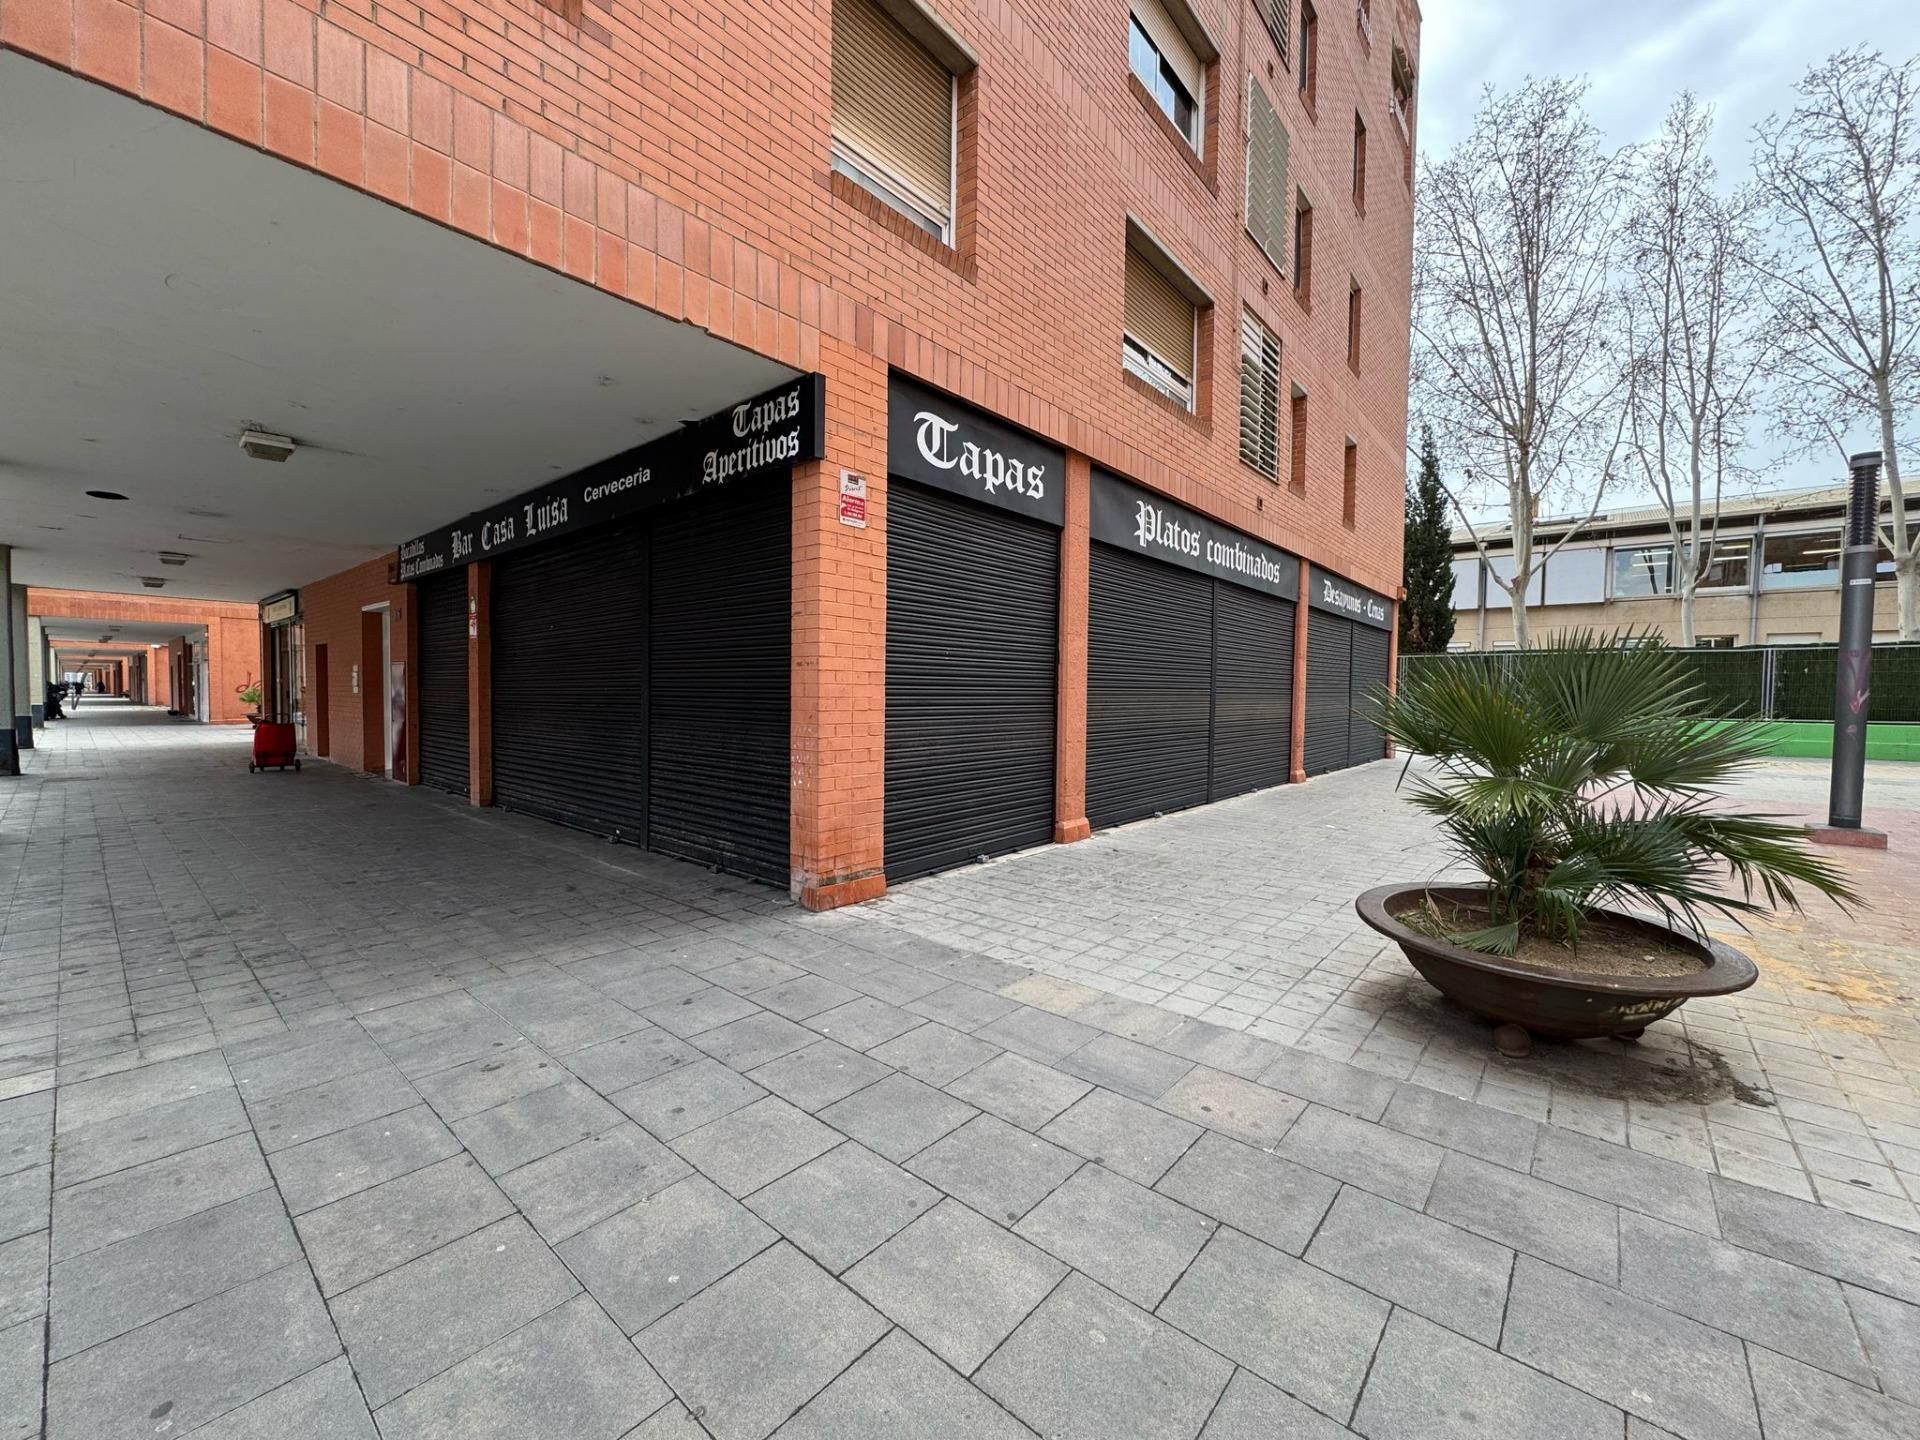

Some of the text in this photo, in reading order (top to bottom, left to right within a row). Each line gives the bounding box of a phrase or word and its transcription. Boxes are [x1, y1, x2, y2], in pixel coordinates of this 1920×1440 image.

[732, 386, 800, 438] Tapas
[702, 426, 800, 484] Aperitivos
[913, 411, 1046, 500] Tapas
[583, 467, 651, 503] Cerveceria
[451, 495, 569, 565] Bar Casa Luisa
[1134, 500, 1281, 584] Platos combinados
[1367, 598, 1385, 622] Cenas
